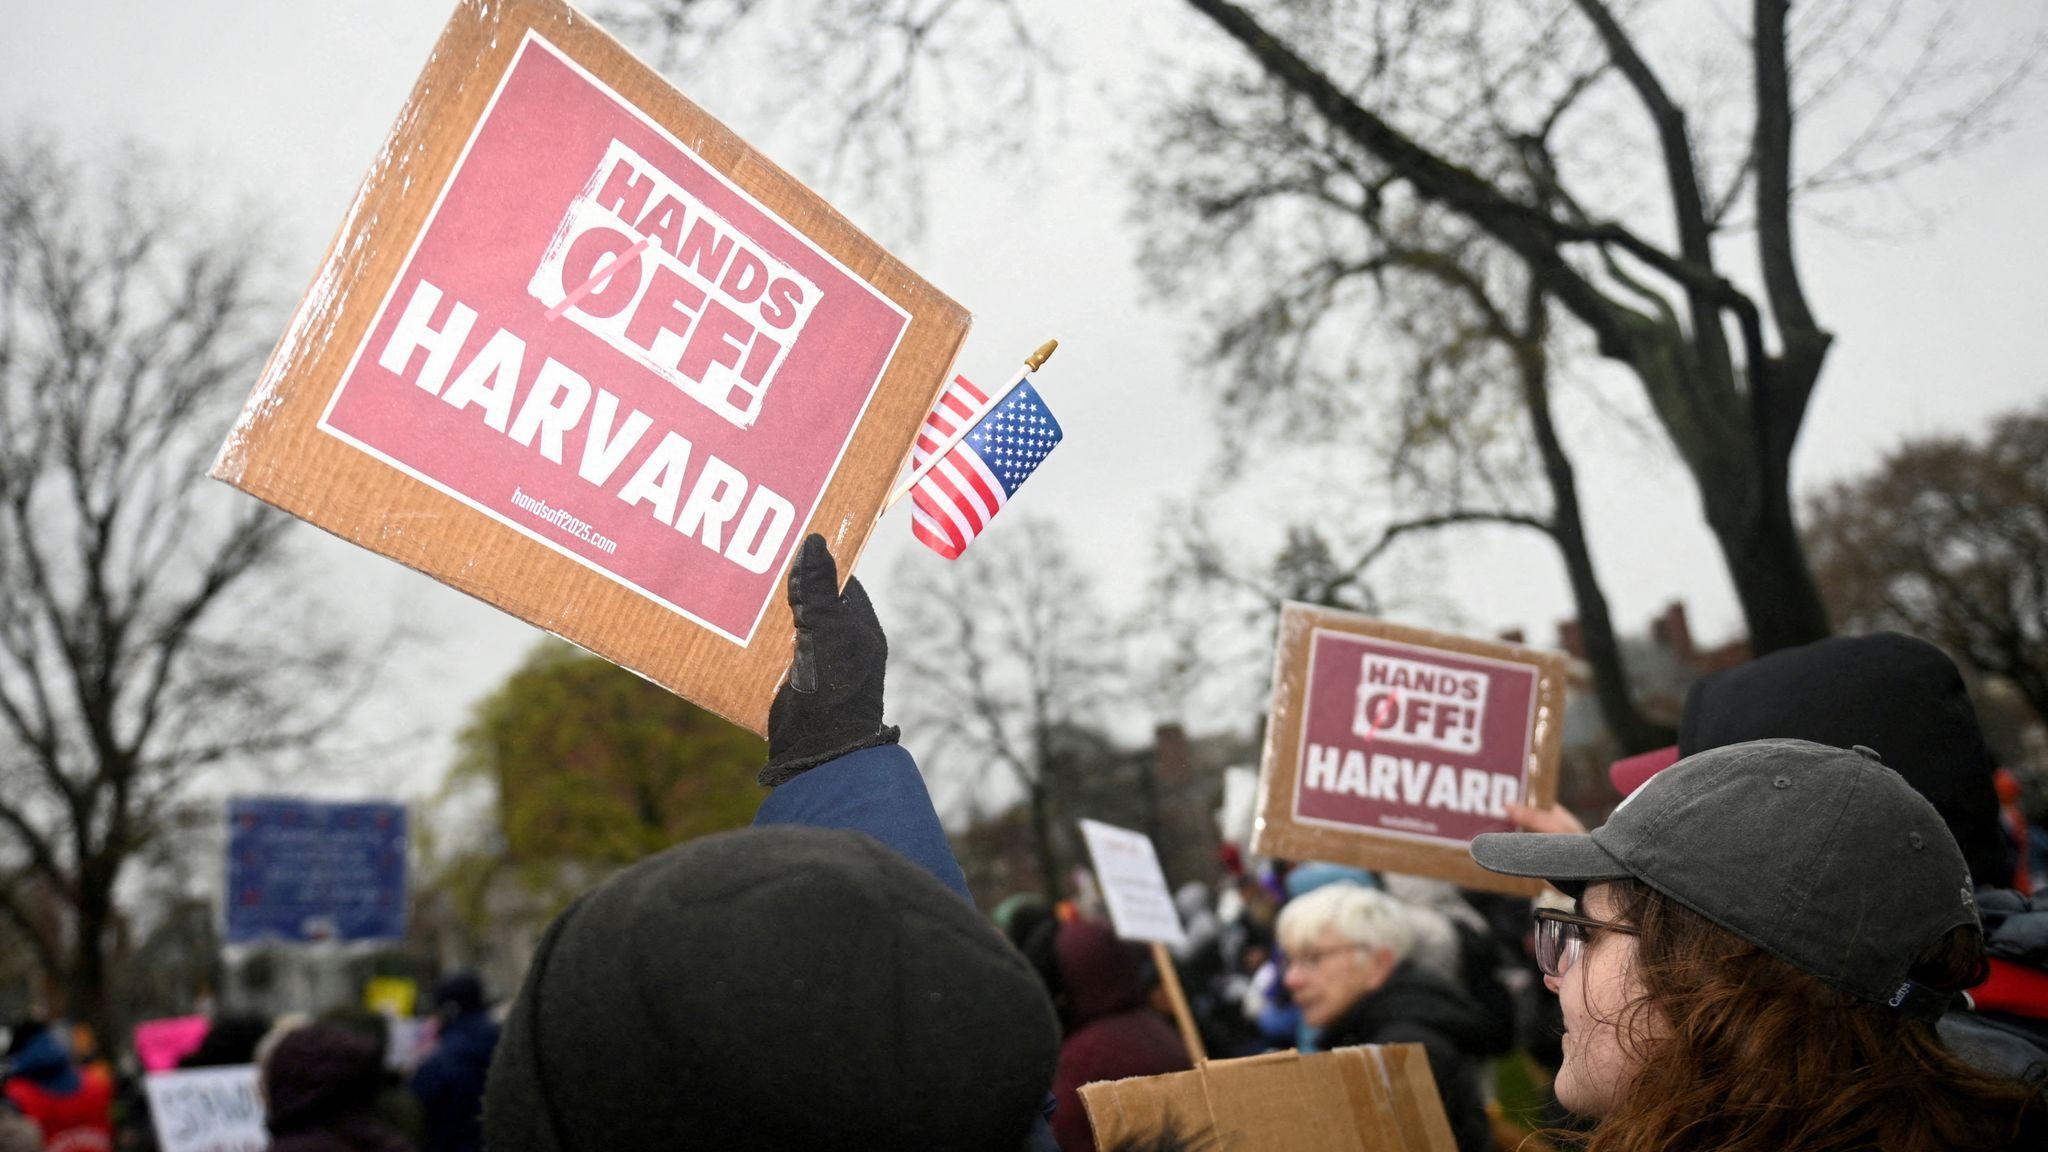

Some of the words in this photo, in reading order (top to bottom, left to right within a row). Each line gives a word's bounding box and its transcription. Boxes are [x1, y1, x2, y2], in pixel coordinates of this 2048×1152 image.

[595, 158, 804, 330] HANDS
[561, 226, 782, 413] OFF!
[378, 278, 796, 575] HARVARD
[511, 486, 617, 555] handsoff2025.com
[1365, 693, 1475, 744] OFF!
[1368, 663, 1479, 700] HANDS
[1305, 743, 1520, 817] HARVARD
